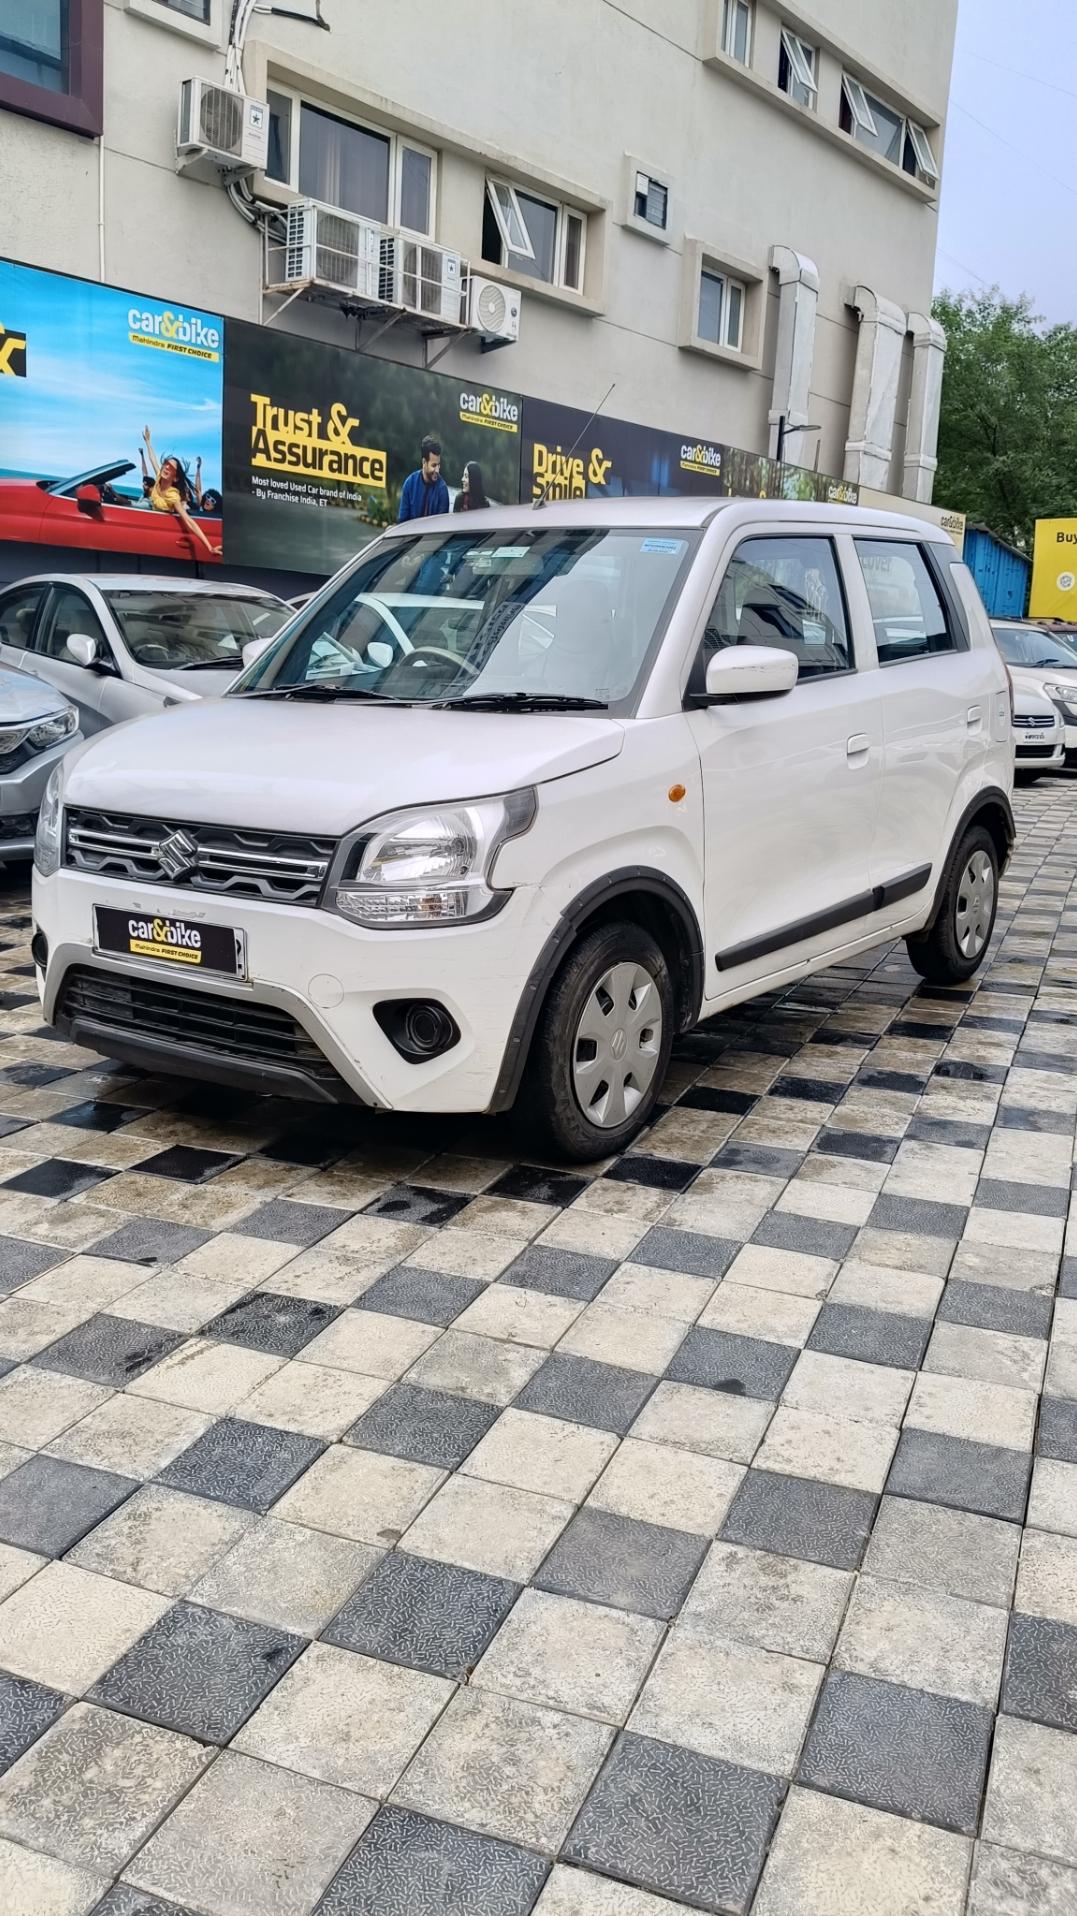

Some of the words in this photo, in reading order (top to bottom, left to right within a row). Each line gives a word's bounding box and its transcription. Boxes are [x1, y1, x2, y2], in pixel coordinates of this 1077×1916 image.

[128, 309, 219, 348] car&bike
[167, 343, 188, 353] FIRST
[188, 347, 212, 359] CHOICE
[250, 393, 322, 439] Trust
[327, 402, 360, 447] &
[460, 393, 518, 421] car&bike
[251, 427, 384, 482] Assurance
[533, 443, 584, 481] Drive
[588, 448, 612, 485] &
[681, 445, 721, 468] car&bike
[251, 476, 269, 487] Most
[270, 478, 289, 490] loved
[289, 482, 307, 492] Used
[308, 485, 318, 494] Car
[319, 487, 338, 498] brand
[339, 490, 346, 499] of
[346, 492, 362, 502] India
[256, 488, 266, 499] By
[267, 489, 299, 504] Franchise
[300, 495, 318, 507] India,
[319, 498, 328, 507] ET
[128, 919, 201, 948] car&bike
[161, 948, 177, 956] FIRST
[178, 951, 198, 960] CHOICE
